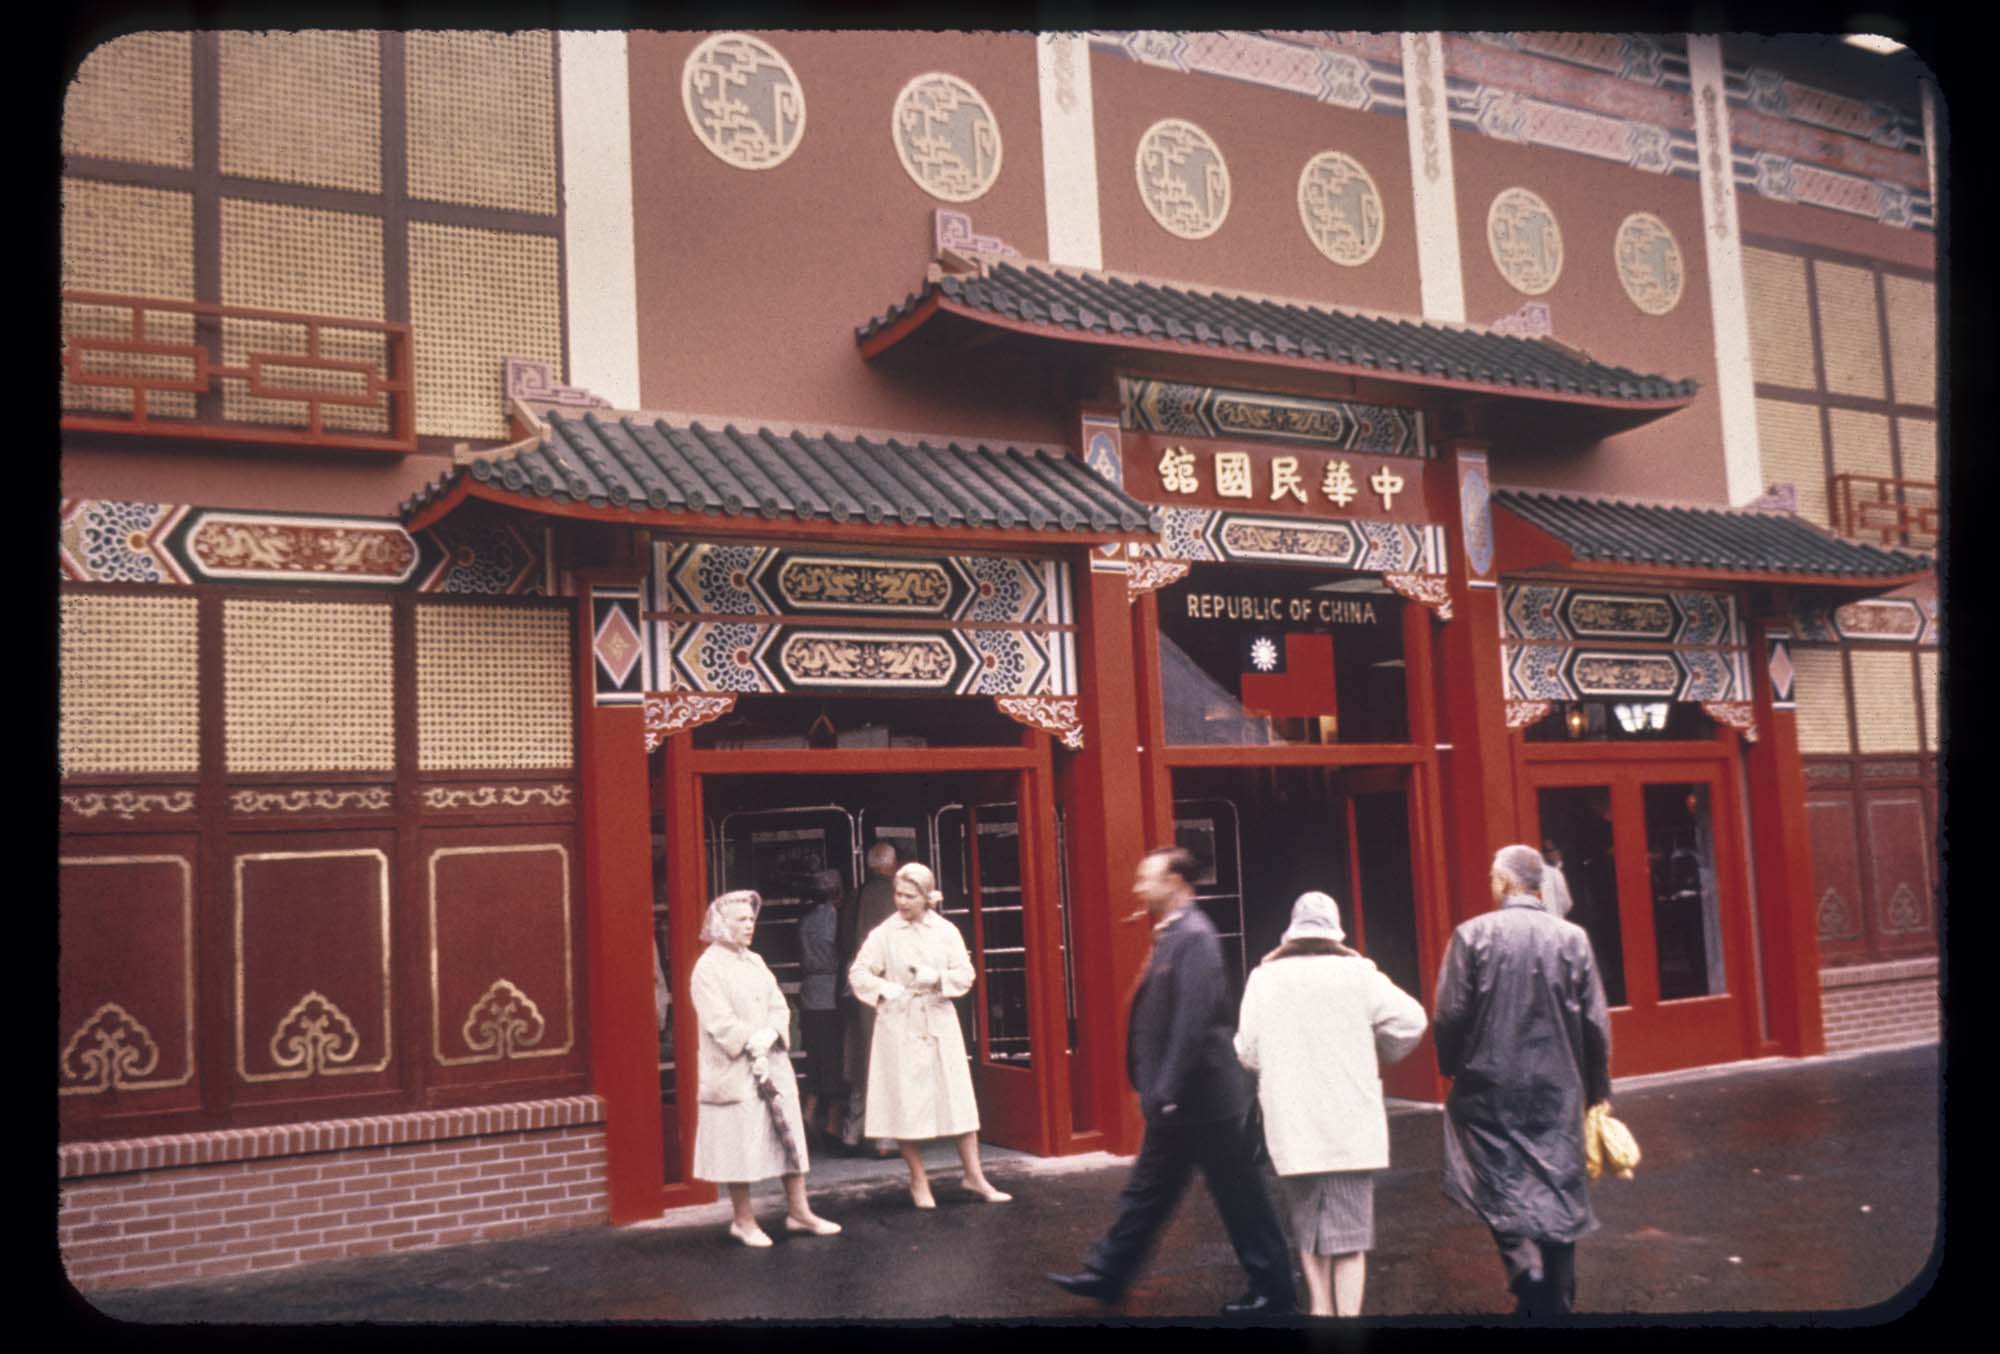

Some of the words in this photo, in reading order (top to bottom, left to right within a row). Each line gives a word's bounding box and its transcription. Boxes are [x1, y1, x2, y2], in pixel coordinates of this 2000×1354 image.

[1186, 593, 1283, 620] REPUBLIC
[1289, 598, 1313, 621] OF
[1318, 599, 1377, 624] CHINA
